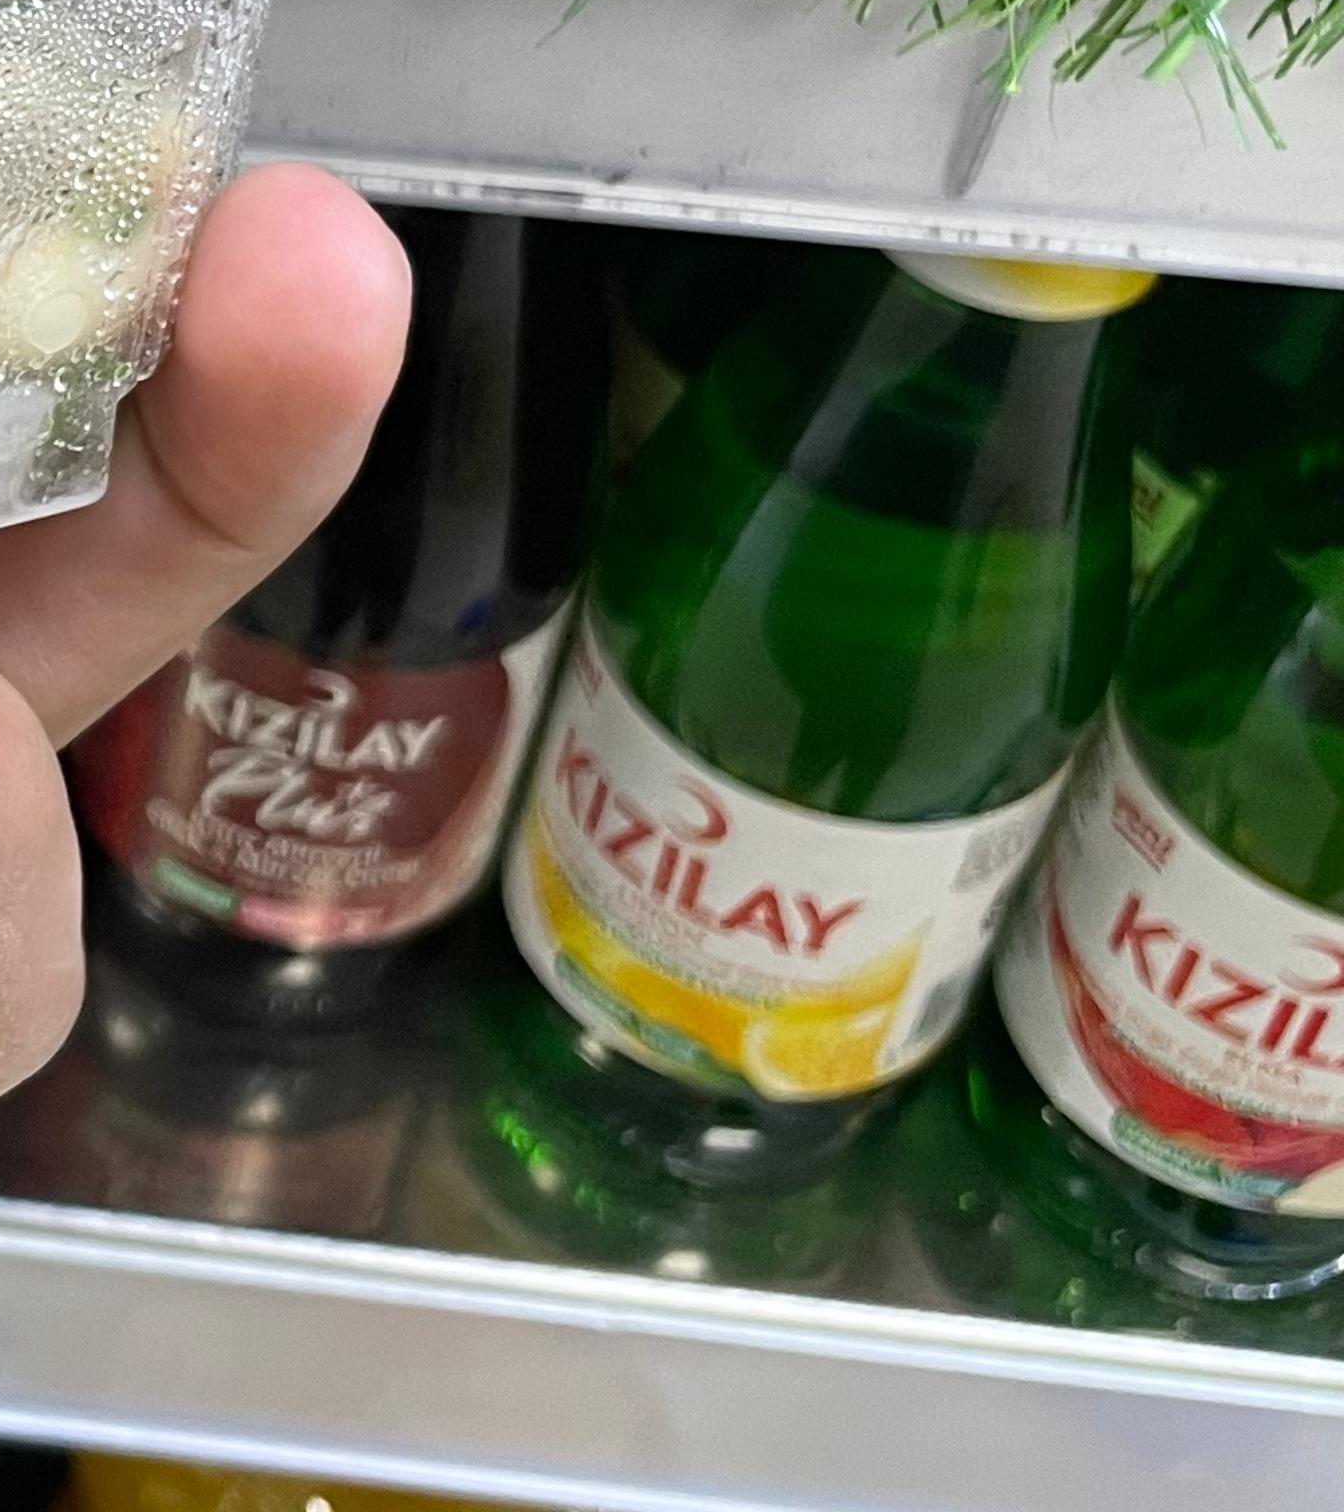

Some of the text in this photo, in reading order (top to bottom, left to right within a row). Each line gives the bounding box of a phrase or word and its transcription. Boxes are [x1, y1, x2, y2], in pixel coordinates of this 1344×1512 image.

[184, 663, 447, 772] KIZILAY
[556, 727, 868, 958] KIZILAY
[1108, 887, 1344, 1076] KIZIL
